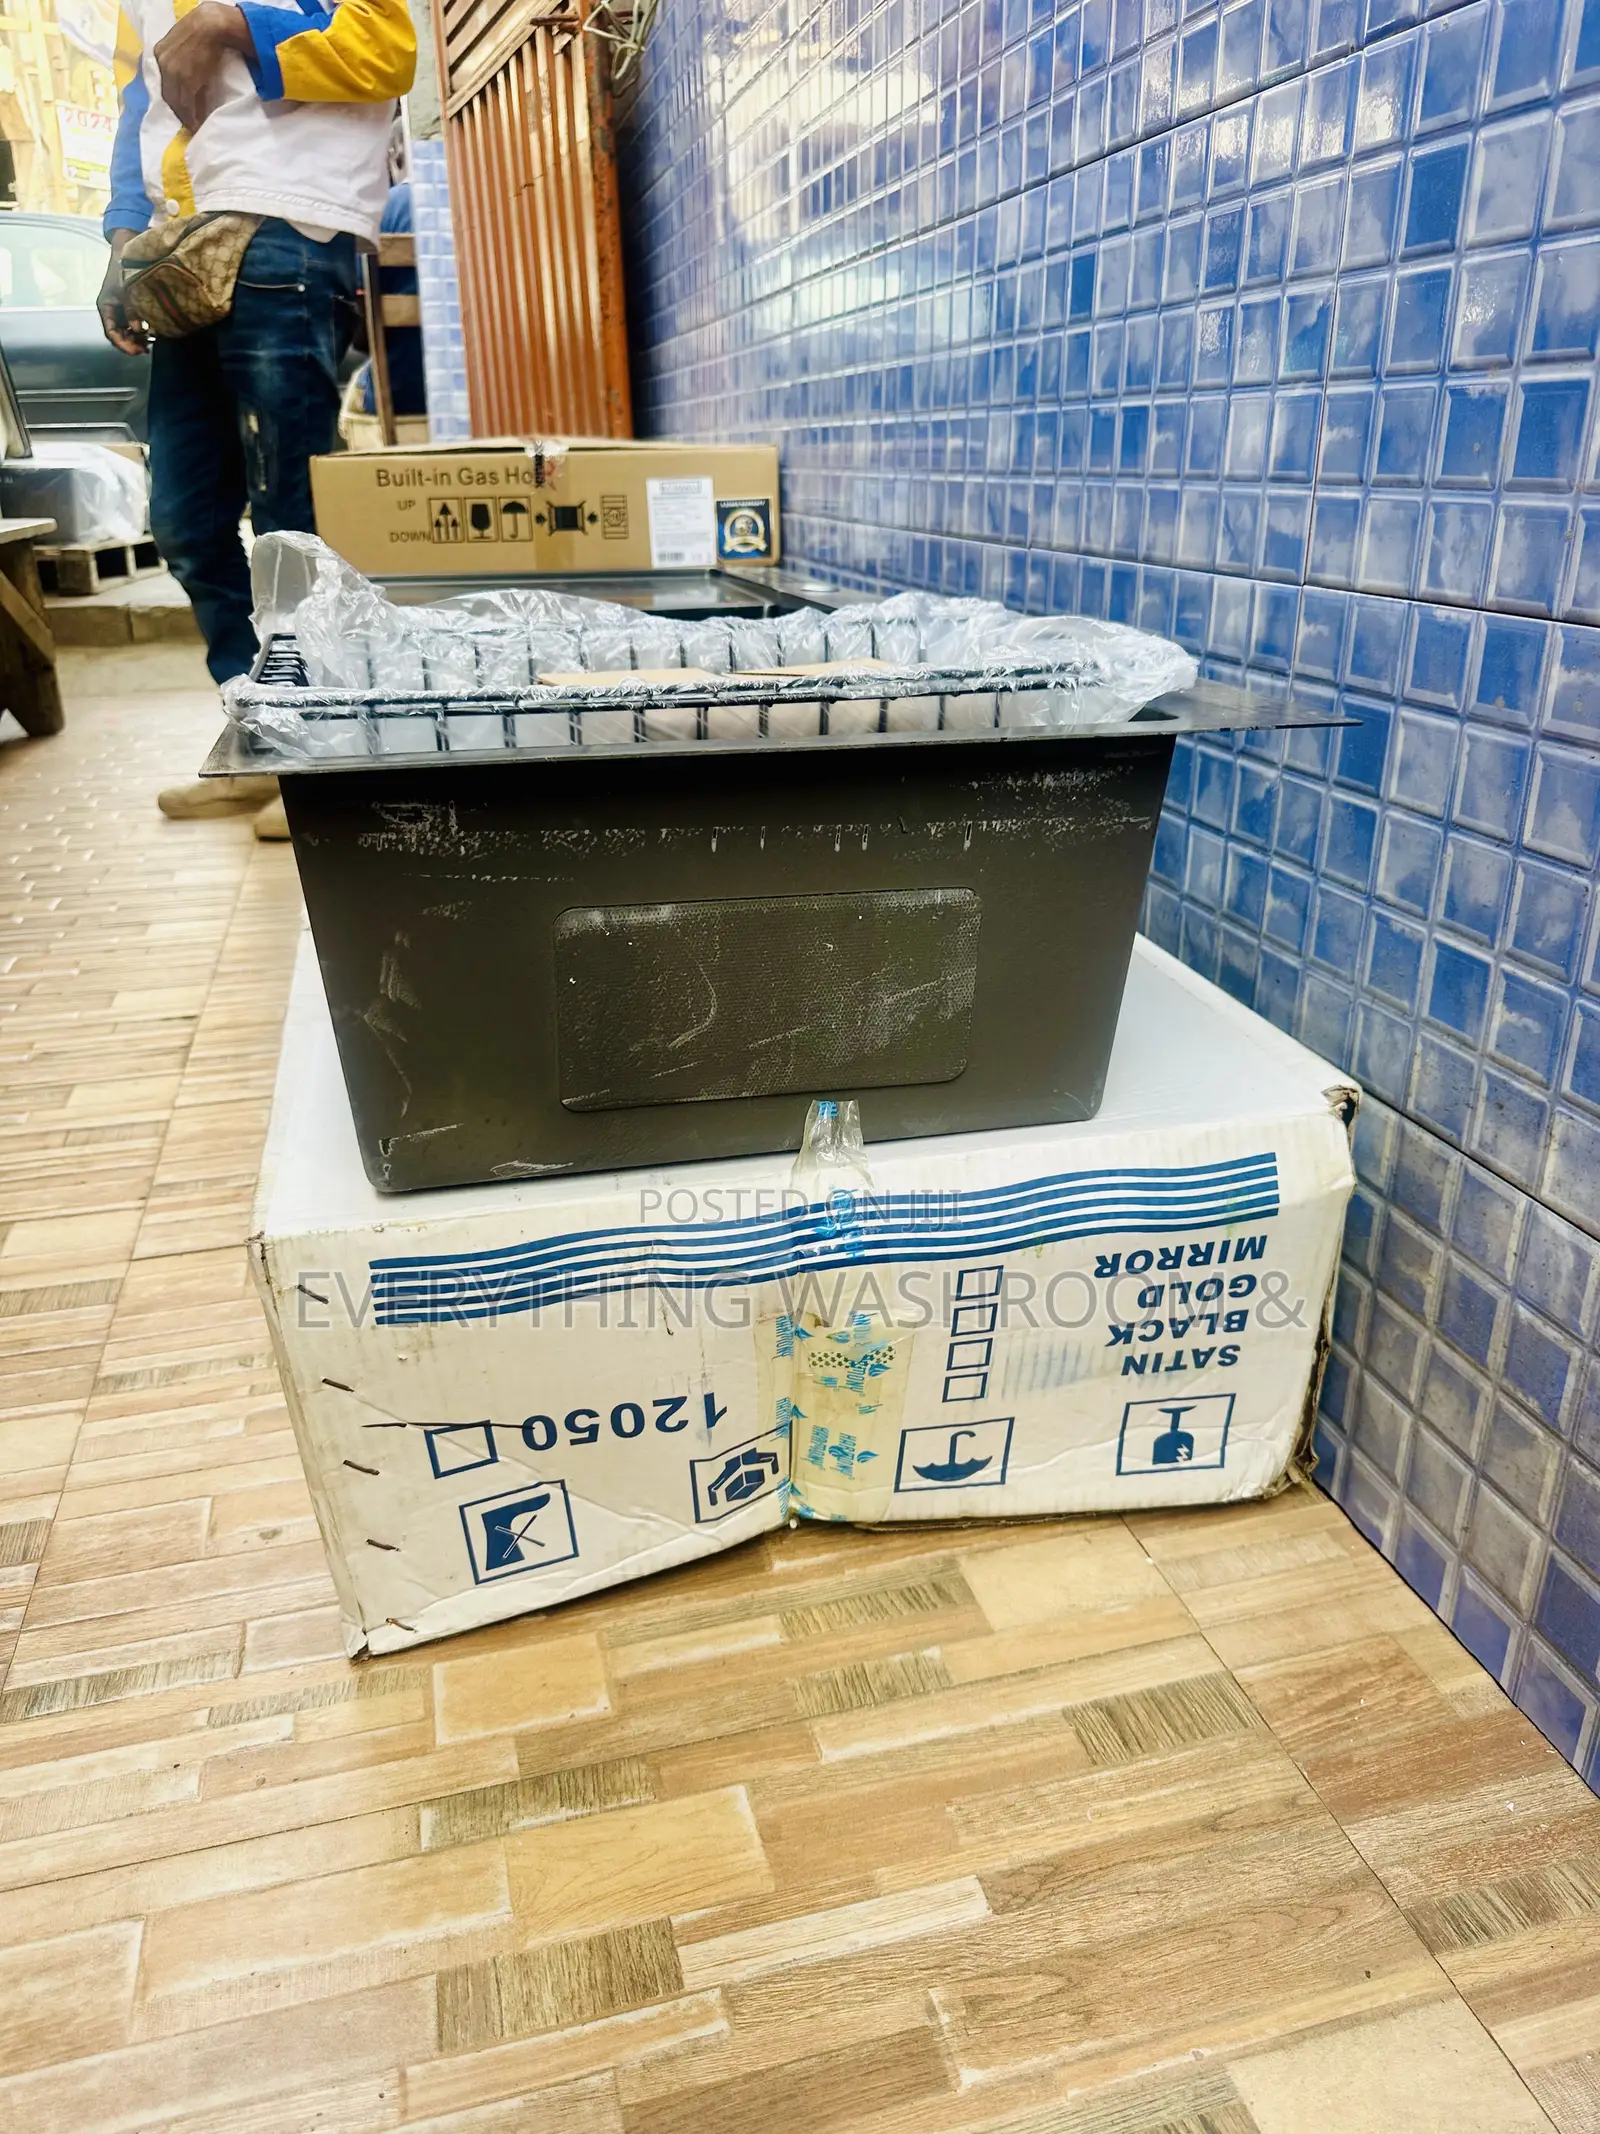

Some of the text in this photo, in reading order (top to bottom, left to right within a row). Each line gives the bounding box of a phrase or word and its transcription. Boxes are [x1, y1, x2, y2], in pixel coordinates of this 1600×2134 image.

[376, 465, 451, 487] Built-in
[457, 467, 499, 486] Gas
[396, 499, 416, 511] UP
[389, 530, 431, 544] DOWN
[1093, 1235, 1268, 1279] MIRROR
[1137, 1274, 1257, 1309] GOLD
[1104, 1309, 1249, 1347] BLACK
[1121, 1344, 1241, 1376] SATIN
[521, 1392, 728, 1451] 12050
